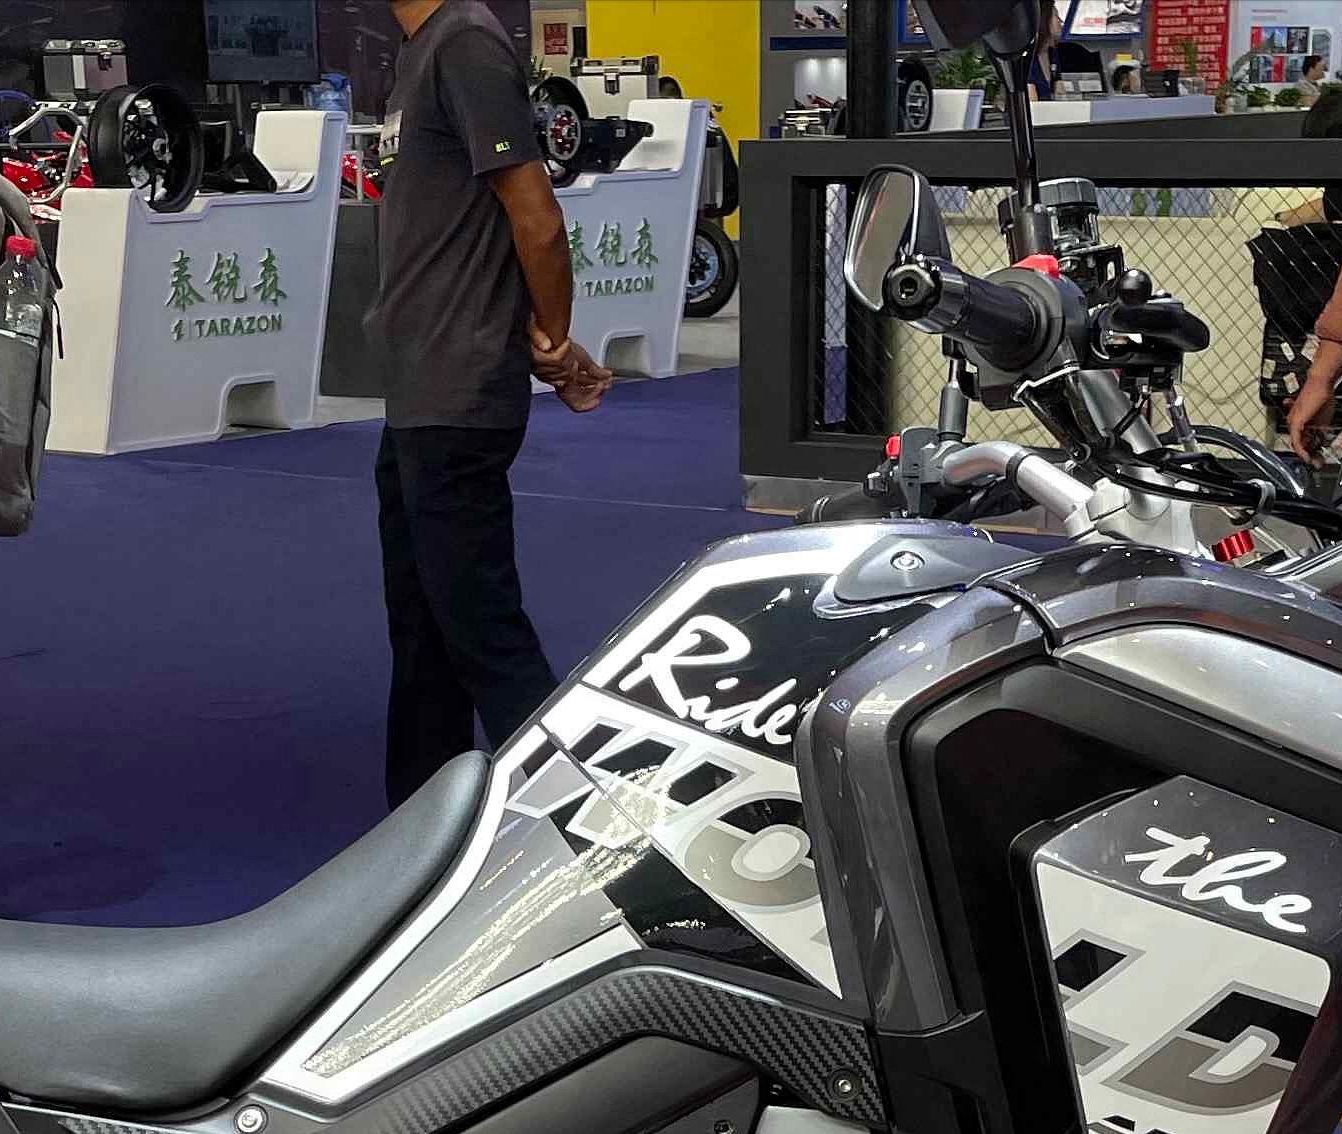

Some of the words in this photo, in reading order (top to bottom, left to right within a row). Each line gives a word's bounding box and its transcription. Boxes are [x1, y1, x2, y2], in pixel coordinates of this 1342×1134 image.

[584, 276, 655, 297] TARAZON
[193, 314, 283, 337] TARAZON
[619, 614, 798, 745] Ride
[1123, 826, 1314, 934] the
